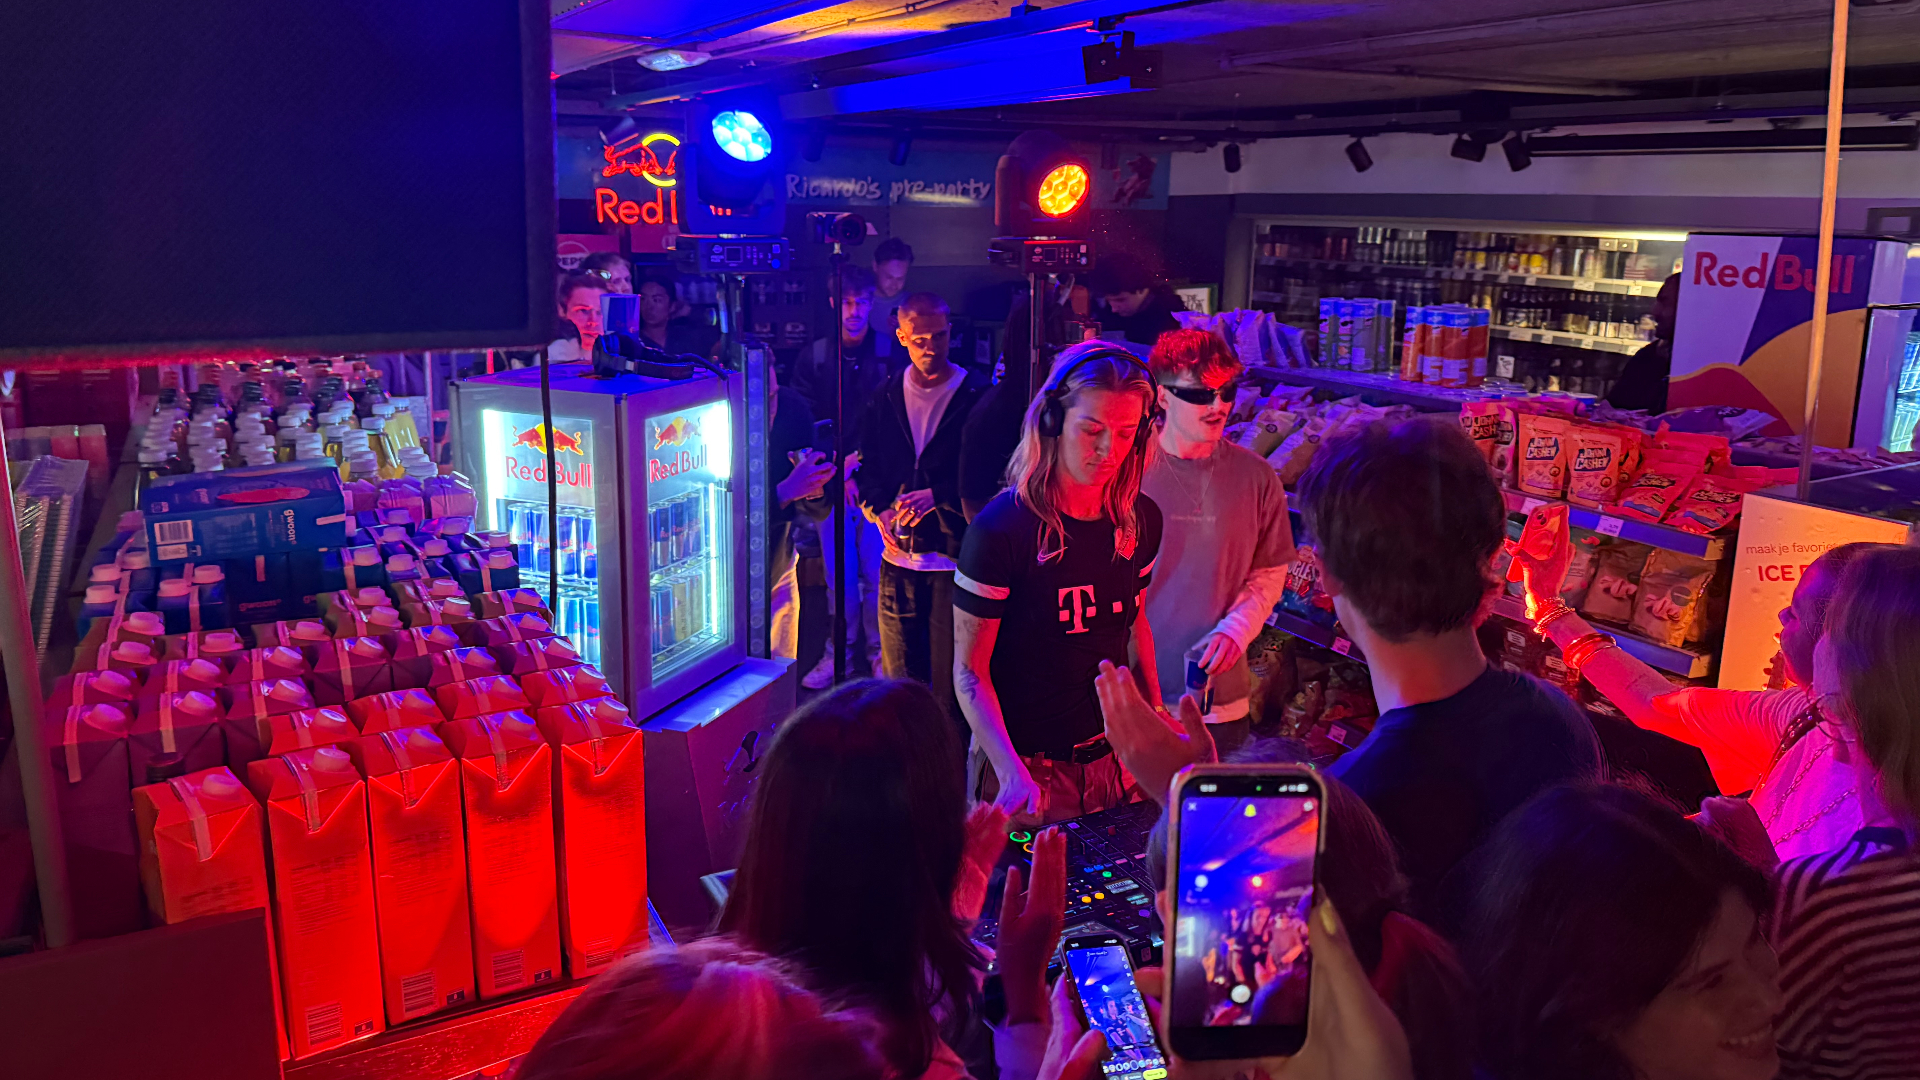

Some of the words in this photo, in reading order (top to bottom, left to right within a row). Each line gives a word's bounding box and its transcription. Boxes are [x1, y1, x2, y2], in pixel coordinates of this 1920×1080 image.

[785, 174, 881, 199] Ricardo's
[890, 178, 991, 204] pre-party
[595, 187, 664, 225] Red
[1693, 252, 1769, 289] Red
[1774, 254, 1856, 294] Bull
[649, 453, 681, 484] Red
[681, 444, 709, 472] Bull
[1526, 446, 1558, 458] CASHEW
[1575, 457, 1610, 470] CASHEW
[505, 456, 547, 483] Red
[554, 461, 594, 489] Bull
[283, 509, 296, 542] gwoon
[1746, 543, 1777, 554] maak
[1778, 542, 1790, 557] je
[1758, 564, 1796, 582] ICE
